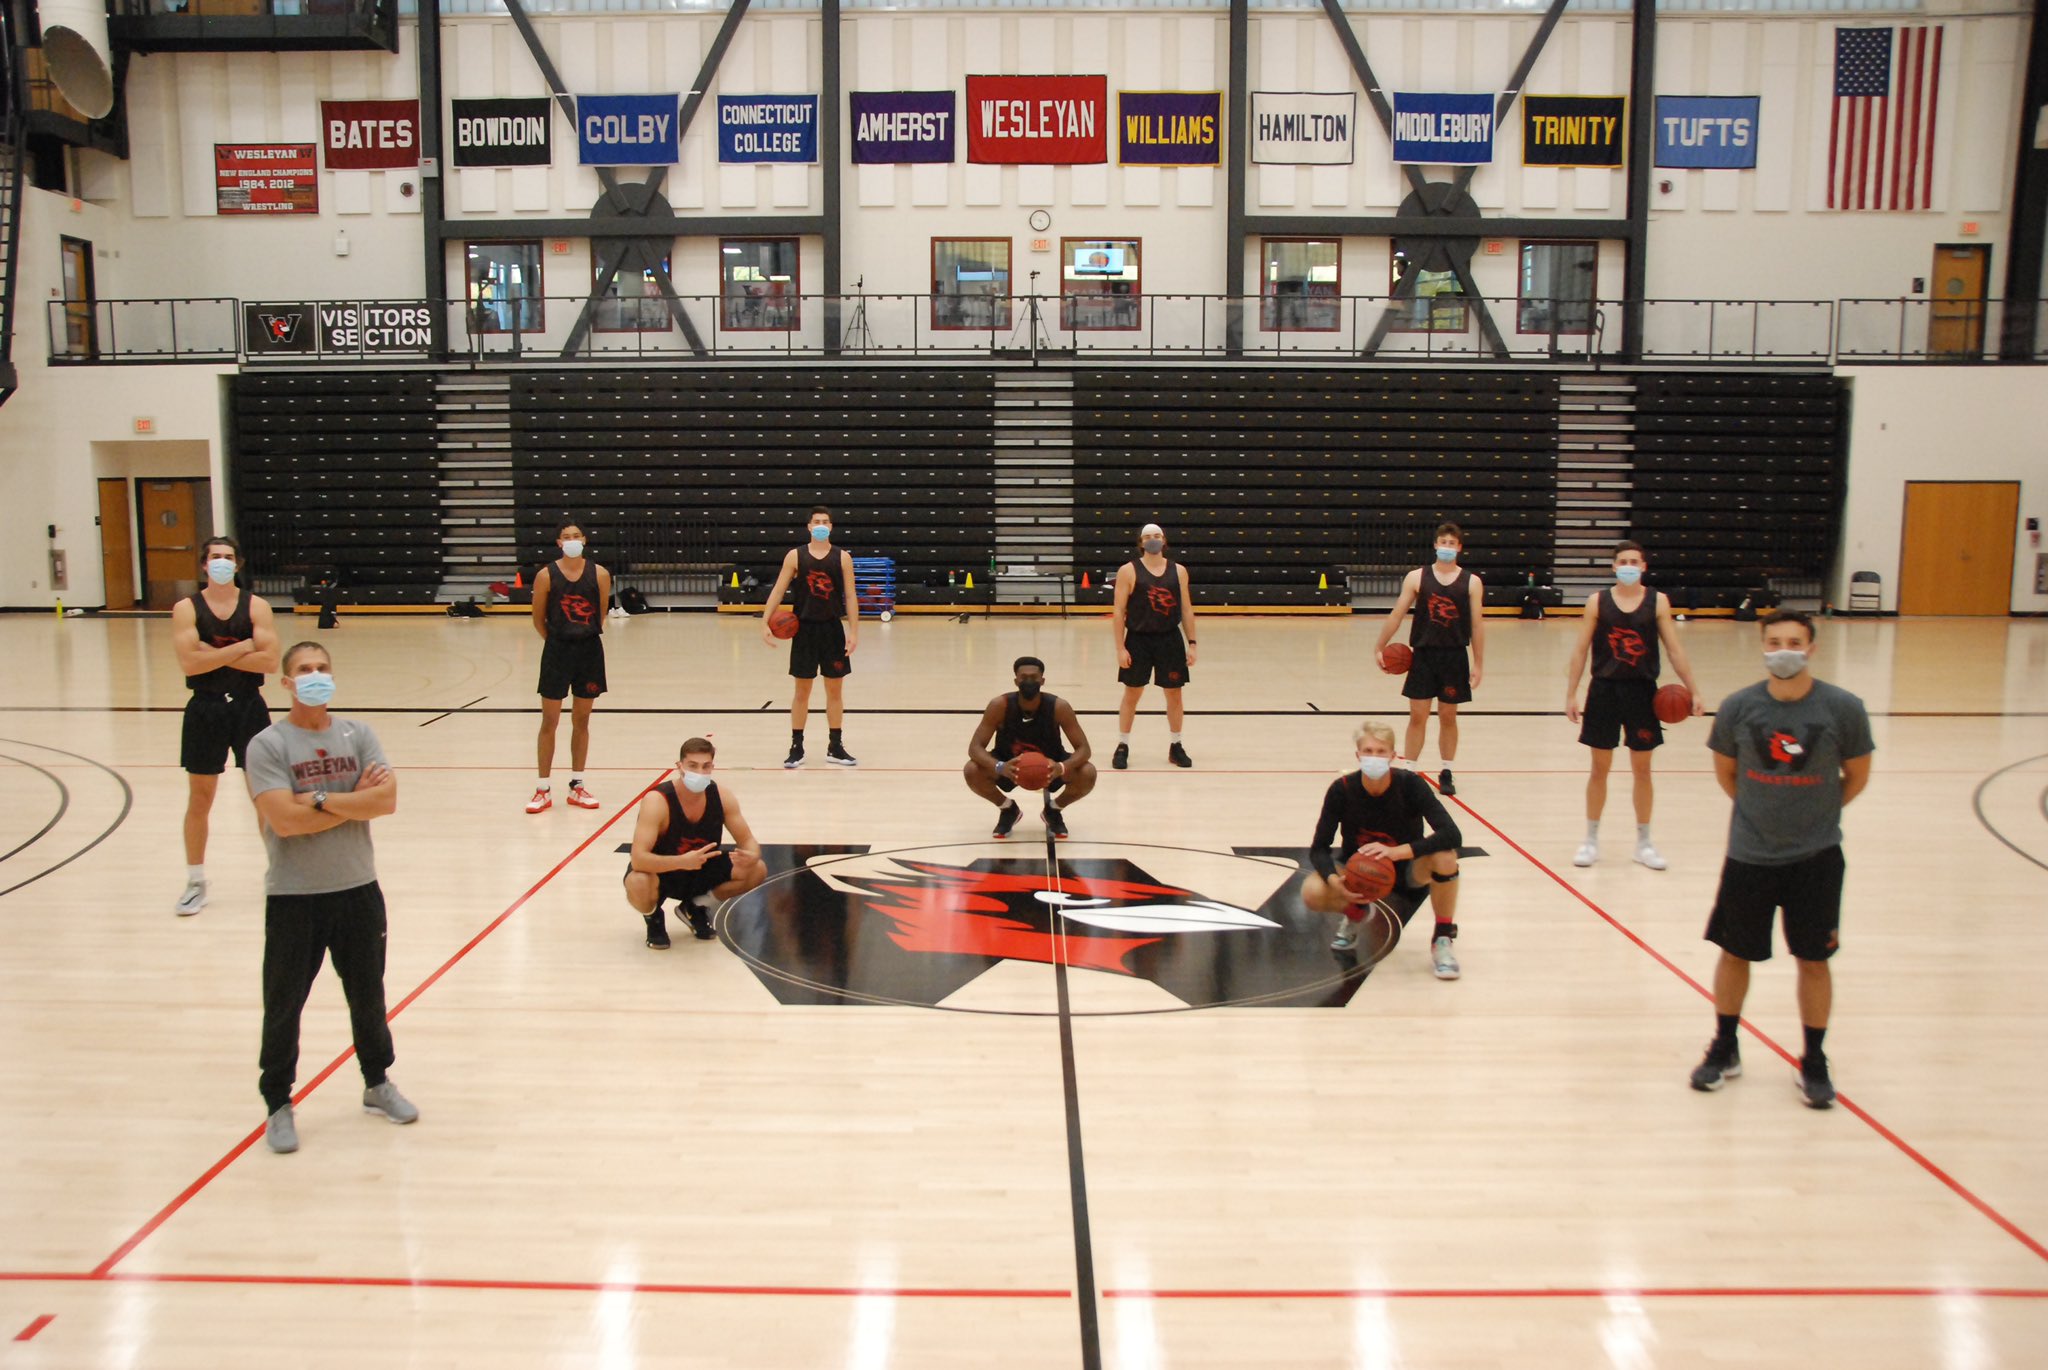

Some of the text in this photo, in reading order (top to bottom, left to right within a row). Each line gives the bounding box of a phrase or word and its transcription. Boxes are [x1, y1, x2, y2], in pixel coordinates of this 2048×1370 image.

[585, 114, 670, 144] COLBY
[722, 103, 813, 125] CONNECTICUT
[857, 111, 949, 142] AMHERST
[980, 99, 1095, 139] WESLEYAN
[1259, 113, 1347, 142] HAMILTON
[1395, 111, 1492, 143] MIDDLEBURY
[330, 119, 413, 149] BATES
[458, 116, 545, 147] BOWDOIN
[734, 132, 802, 153] COLLEGE
[1126, 115, 1214, 145] WILLIAMS
[1532, 115, 1616, 145] TRINITY
[1663, 117, 1750, 147] TUFTS
[234, 149, 297, 159] WESLEYAN
[219, 169, 314, 177] NEW ENGLAND CHAMPIONS
[269, 179, 295, 189] 2012
[242, 202, 294, 211] WRESTLING
[554, 241, 568, 253] EXIT
